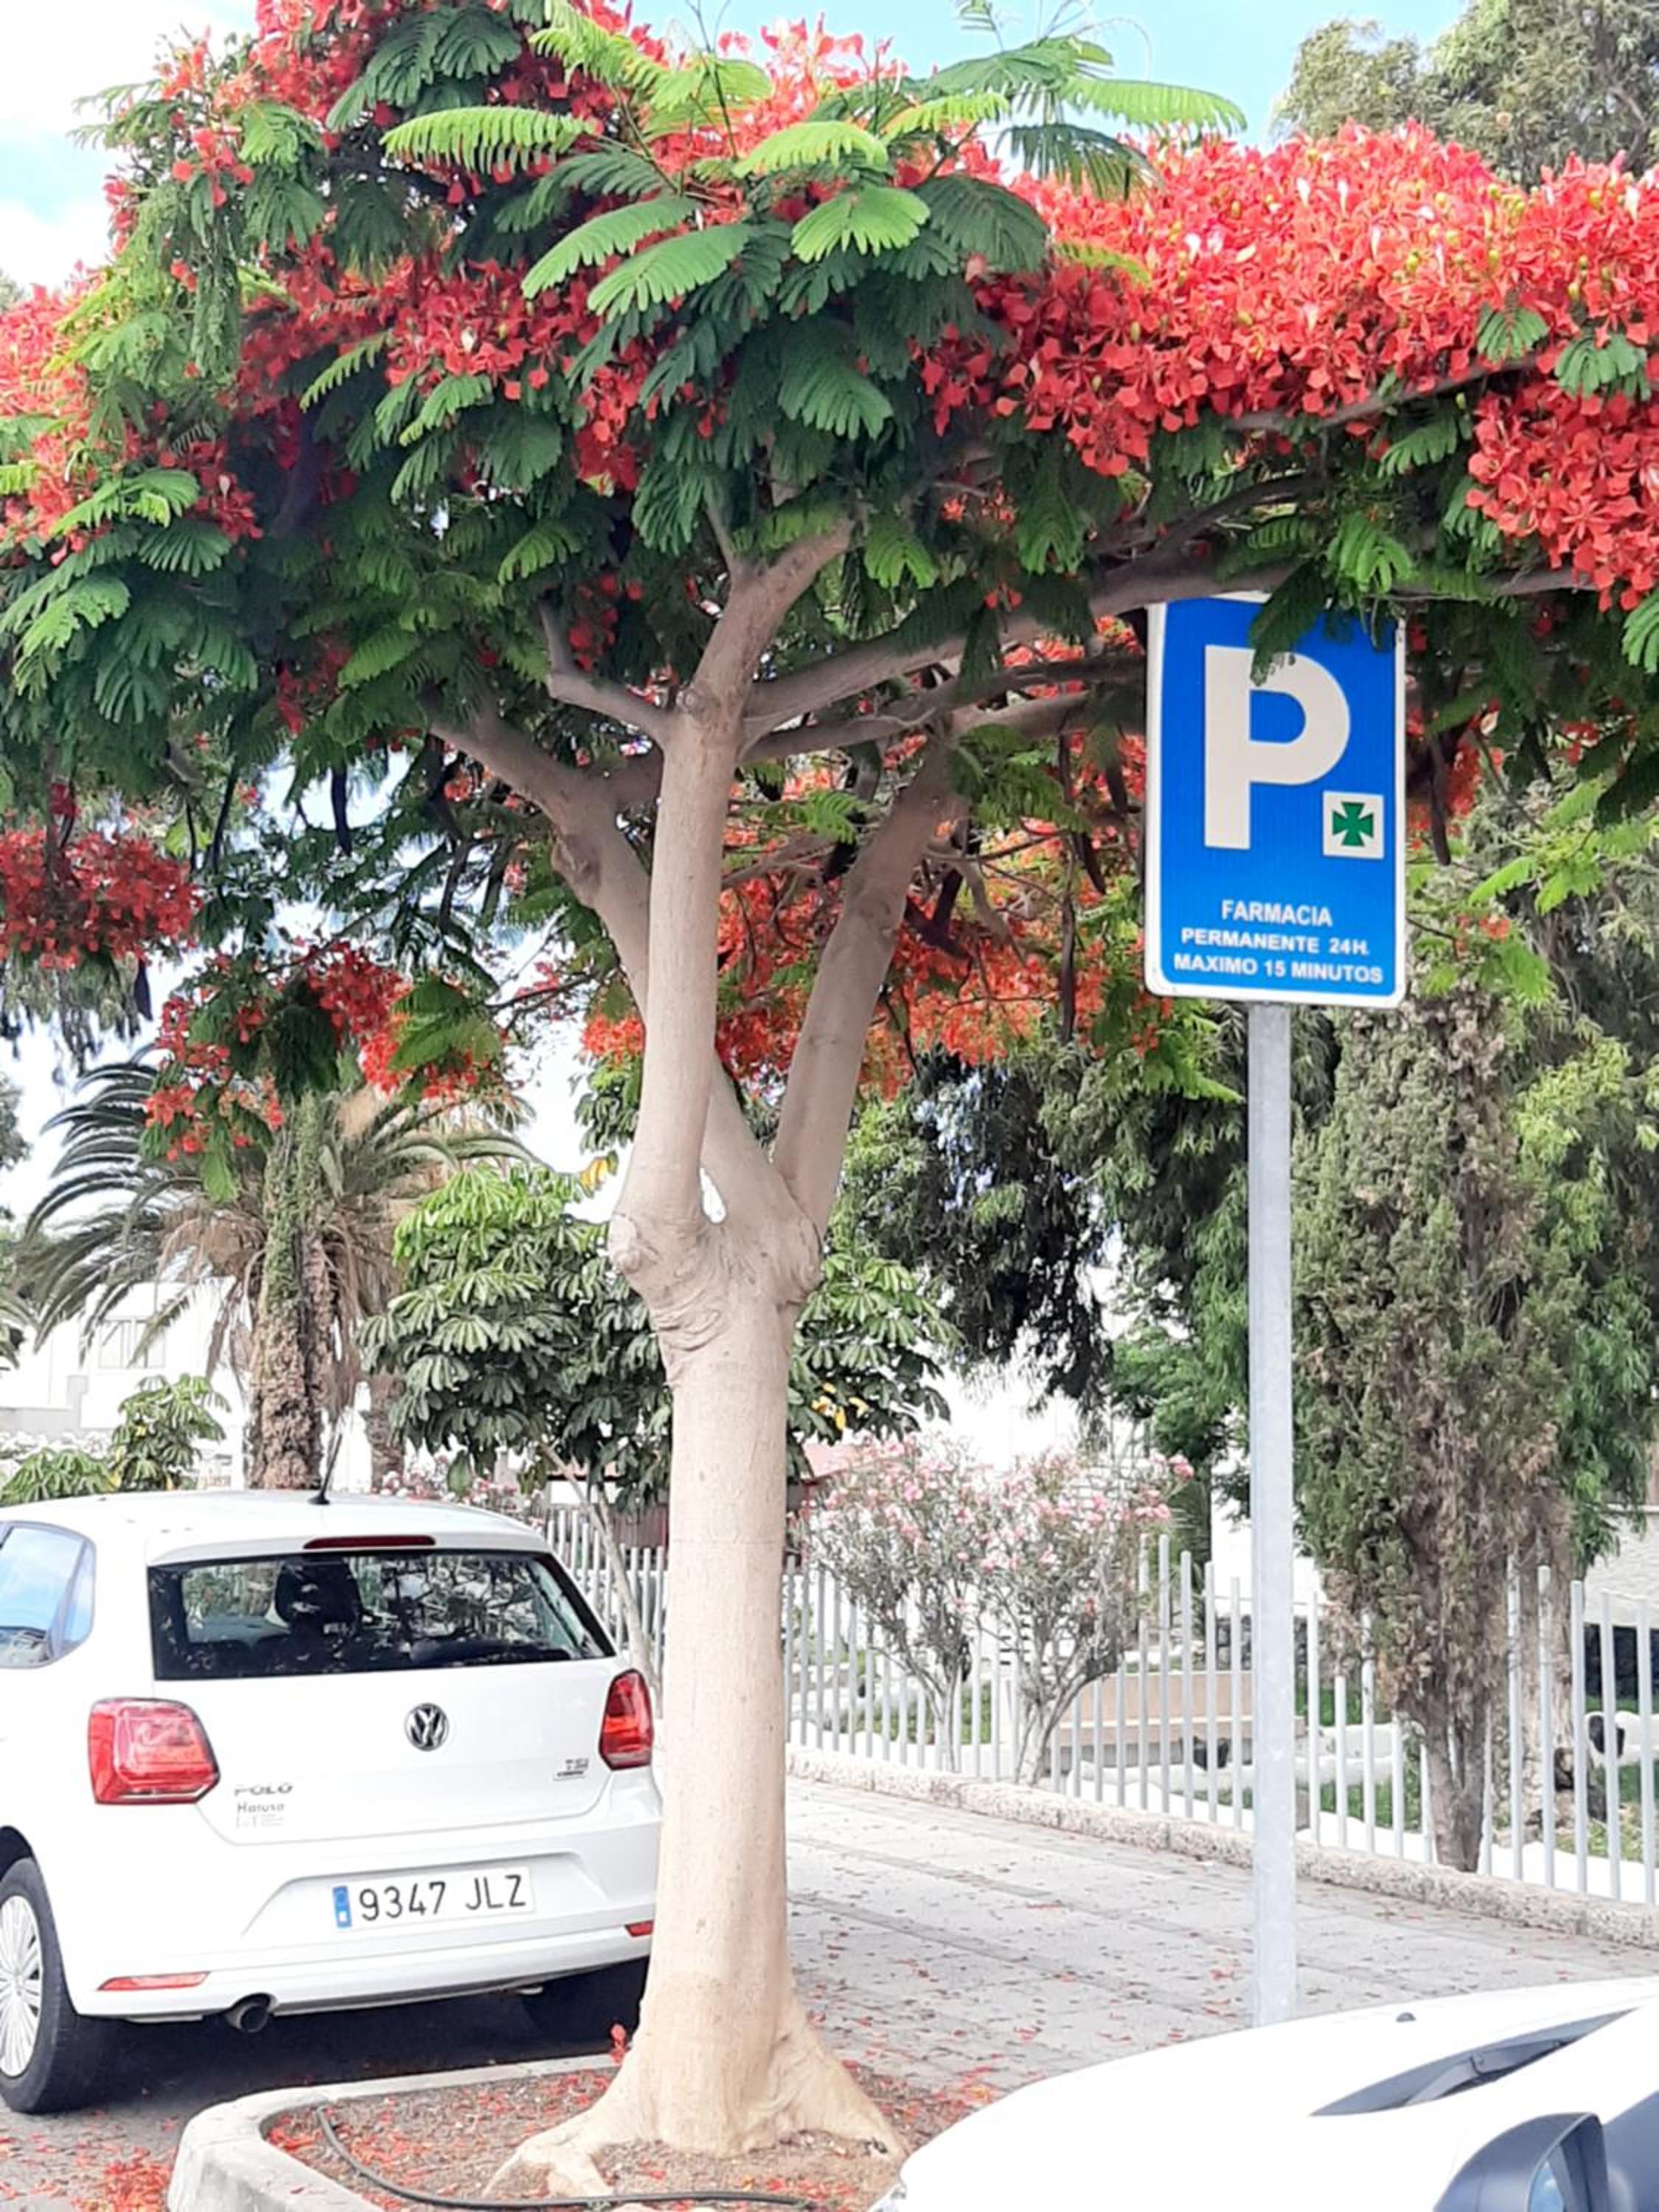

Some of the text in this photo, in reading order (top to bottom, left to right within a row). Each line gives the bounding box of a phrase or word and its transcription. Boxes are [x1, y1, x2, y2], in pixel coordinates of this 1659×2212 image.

[1204, 644, 1351, 850] P
[1221, 899, 1334, 927] FARMACIA
[1181, 927, 1320, 953] PERMANENTE
[1173, 953, 1384, 985] MAXIMO 15 MINUTOS
[234, 1781, 293, 1798] POLO
[358, 1874, 526, 1921] 9347 JLZ
